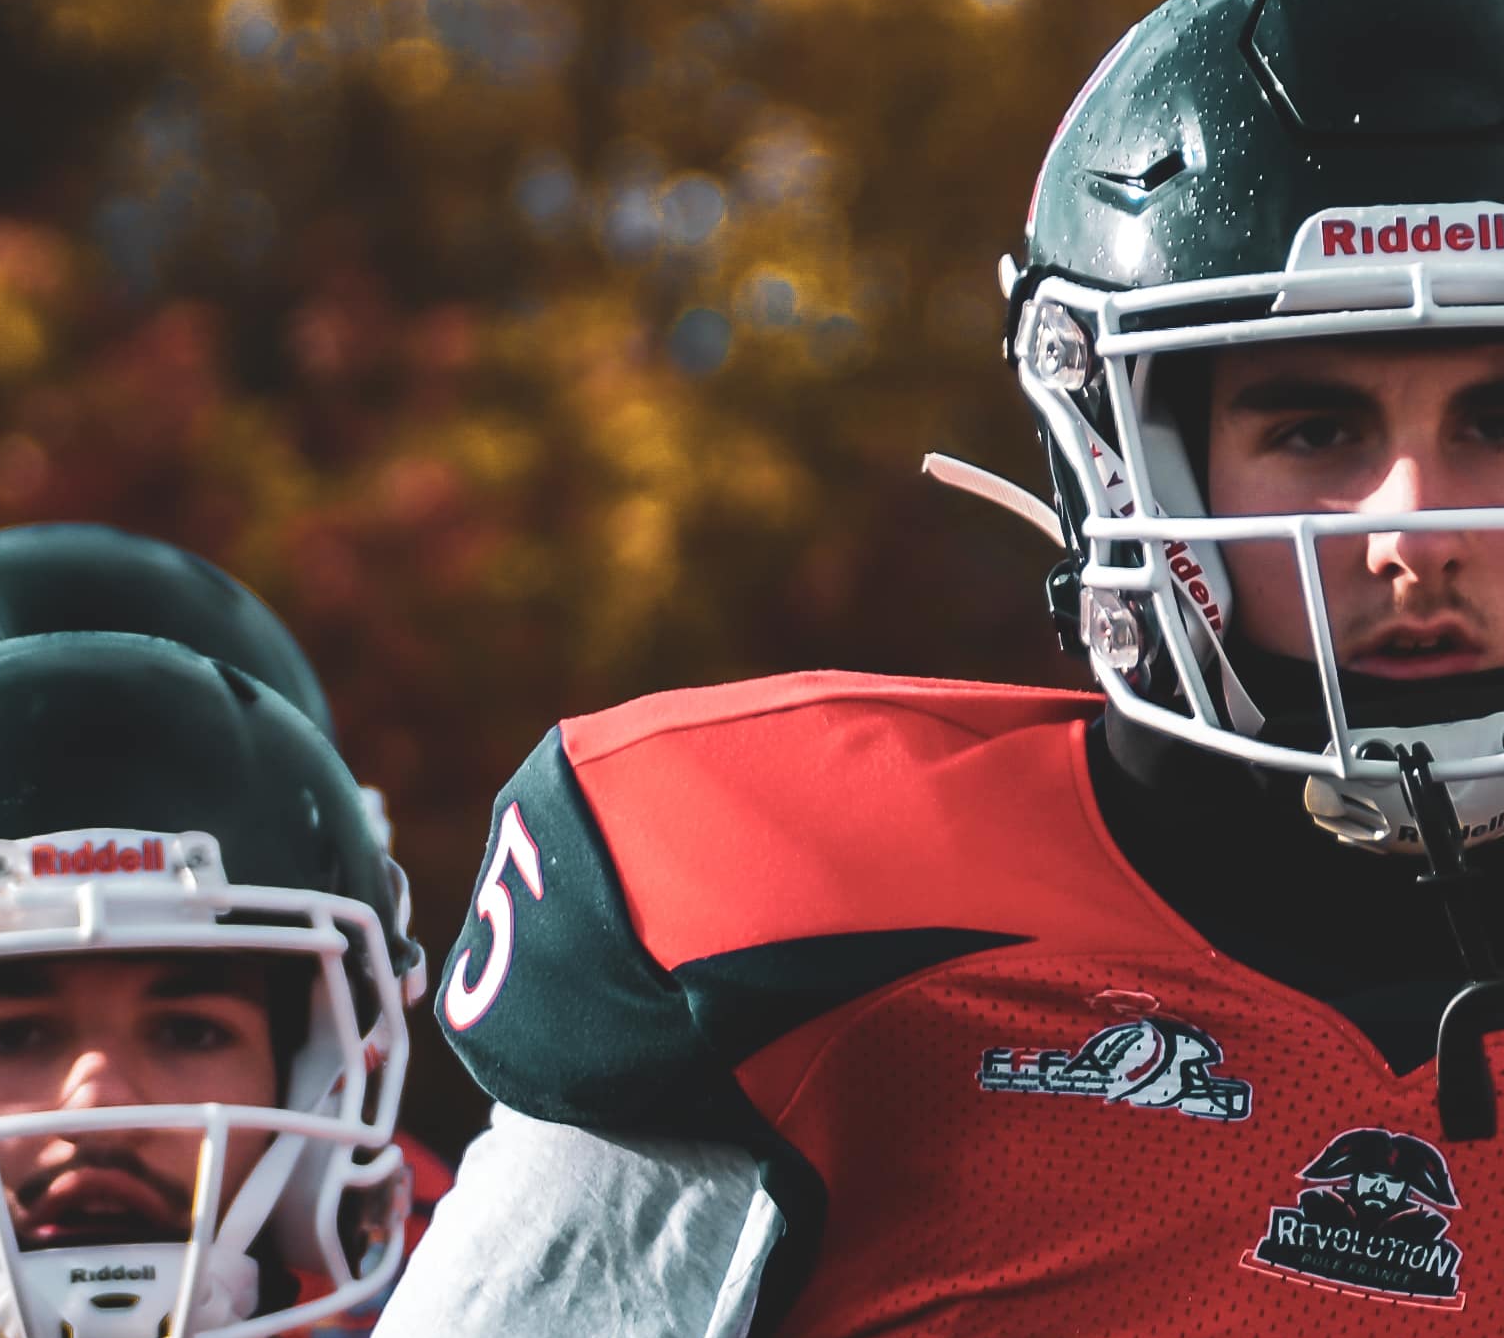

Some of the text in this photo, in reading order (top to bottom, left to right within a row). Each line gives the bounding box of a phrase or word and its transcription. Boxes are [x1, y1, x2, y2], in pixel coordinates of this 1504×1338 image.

[31, 838, 165, 878] Riddell
[444, 800, 545, 1032] 5
[983, 1047, 1111, 1076] FFFA
[1277, 1214, 1453, 1278] REVOLUTION
[70, 1264, 156, 1284] Riddell
